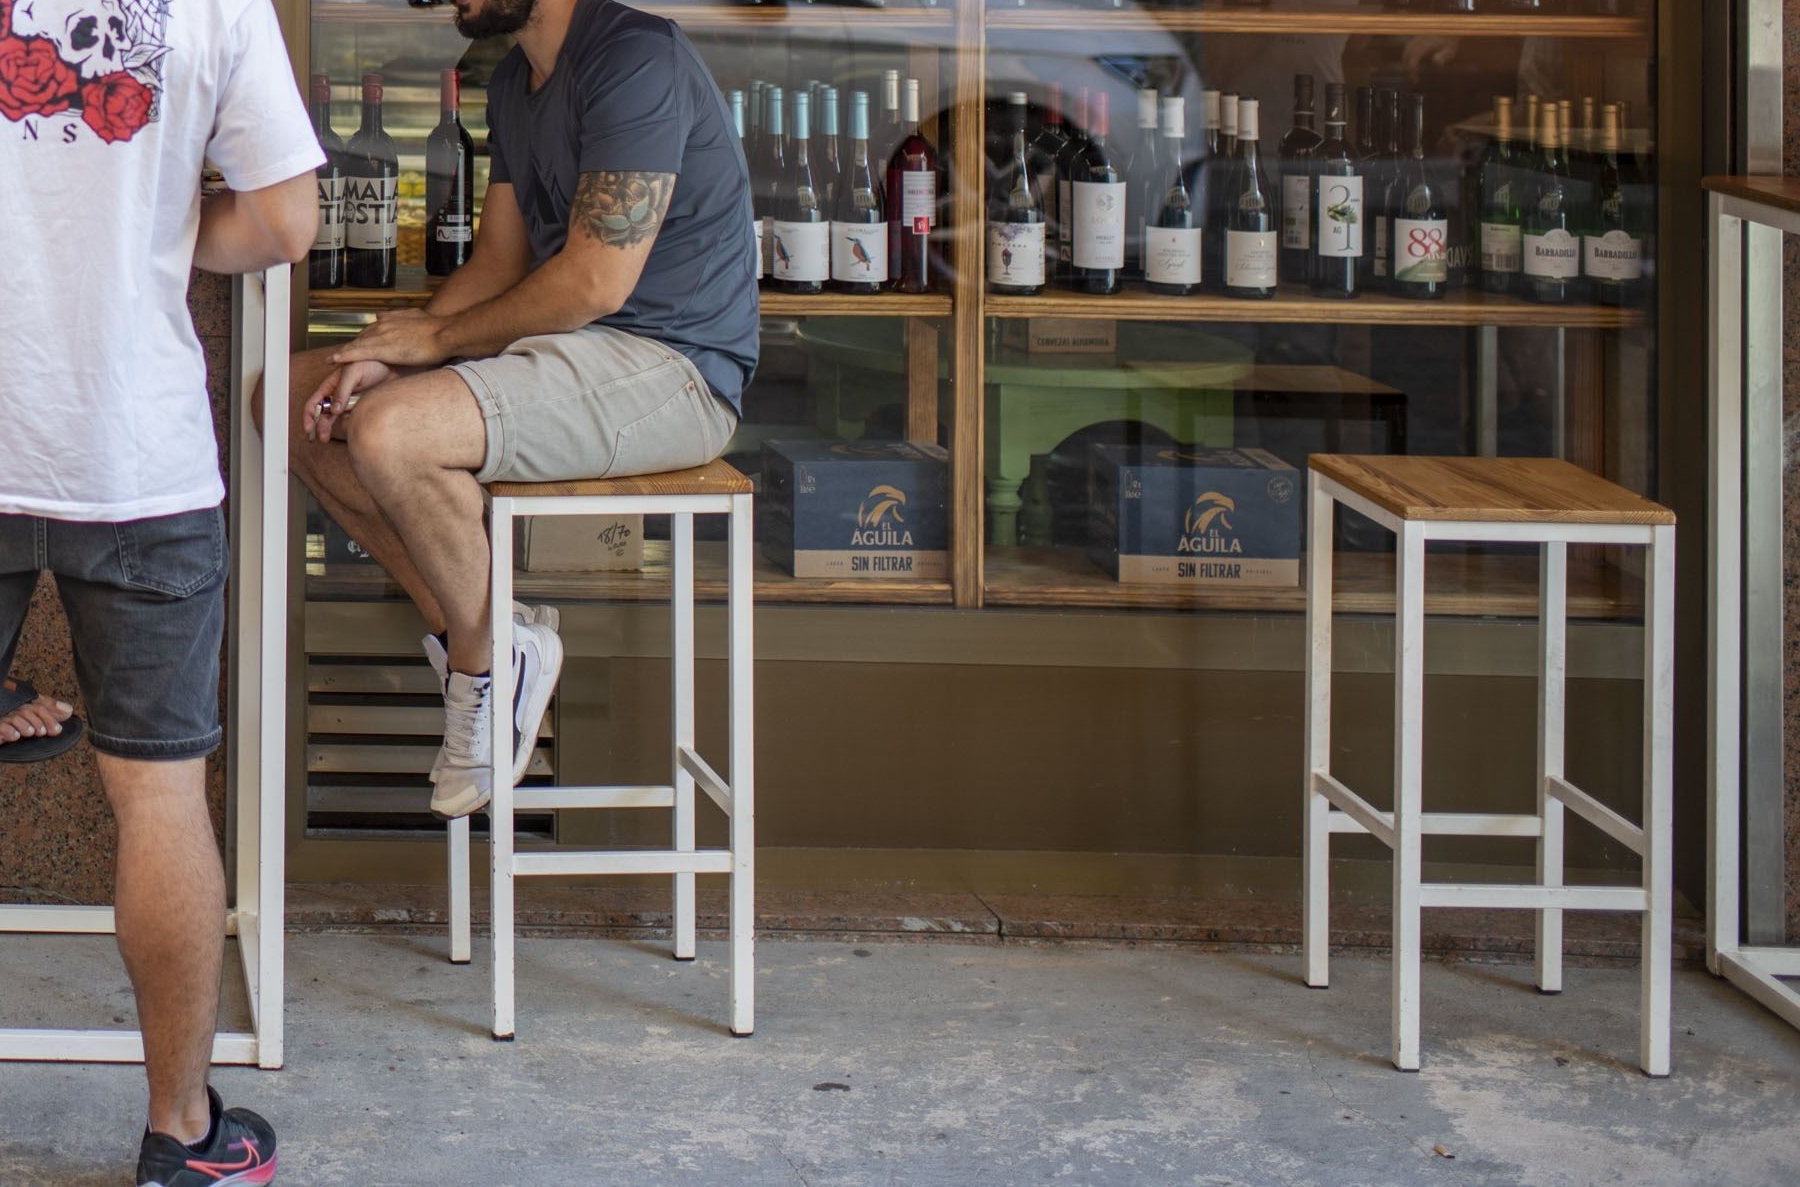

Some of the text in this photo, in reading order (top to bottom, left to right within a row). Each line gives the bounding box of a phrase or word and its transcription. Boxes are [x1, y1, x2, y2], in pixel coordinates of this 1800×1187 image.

[1407, 228, 1444, 258] 88
[882, 521, 892, 531] EL
[1209, 528, 1219, 538] EL
[851, 528, 914, 546] ÁGUILA
[1177, 535, 1243, 553] ÁGUILA
[851, 556, 870, 571] SIN
[873, 556, 913, 571] FILTRAR
[1178, 562, 1196, 578] SIN
[1200, 563, 1241, 579] FILTRAR
